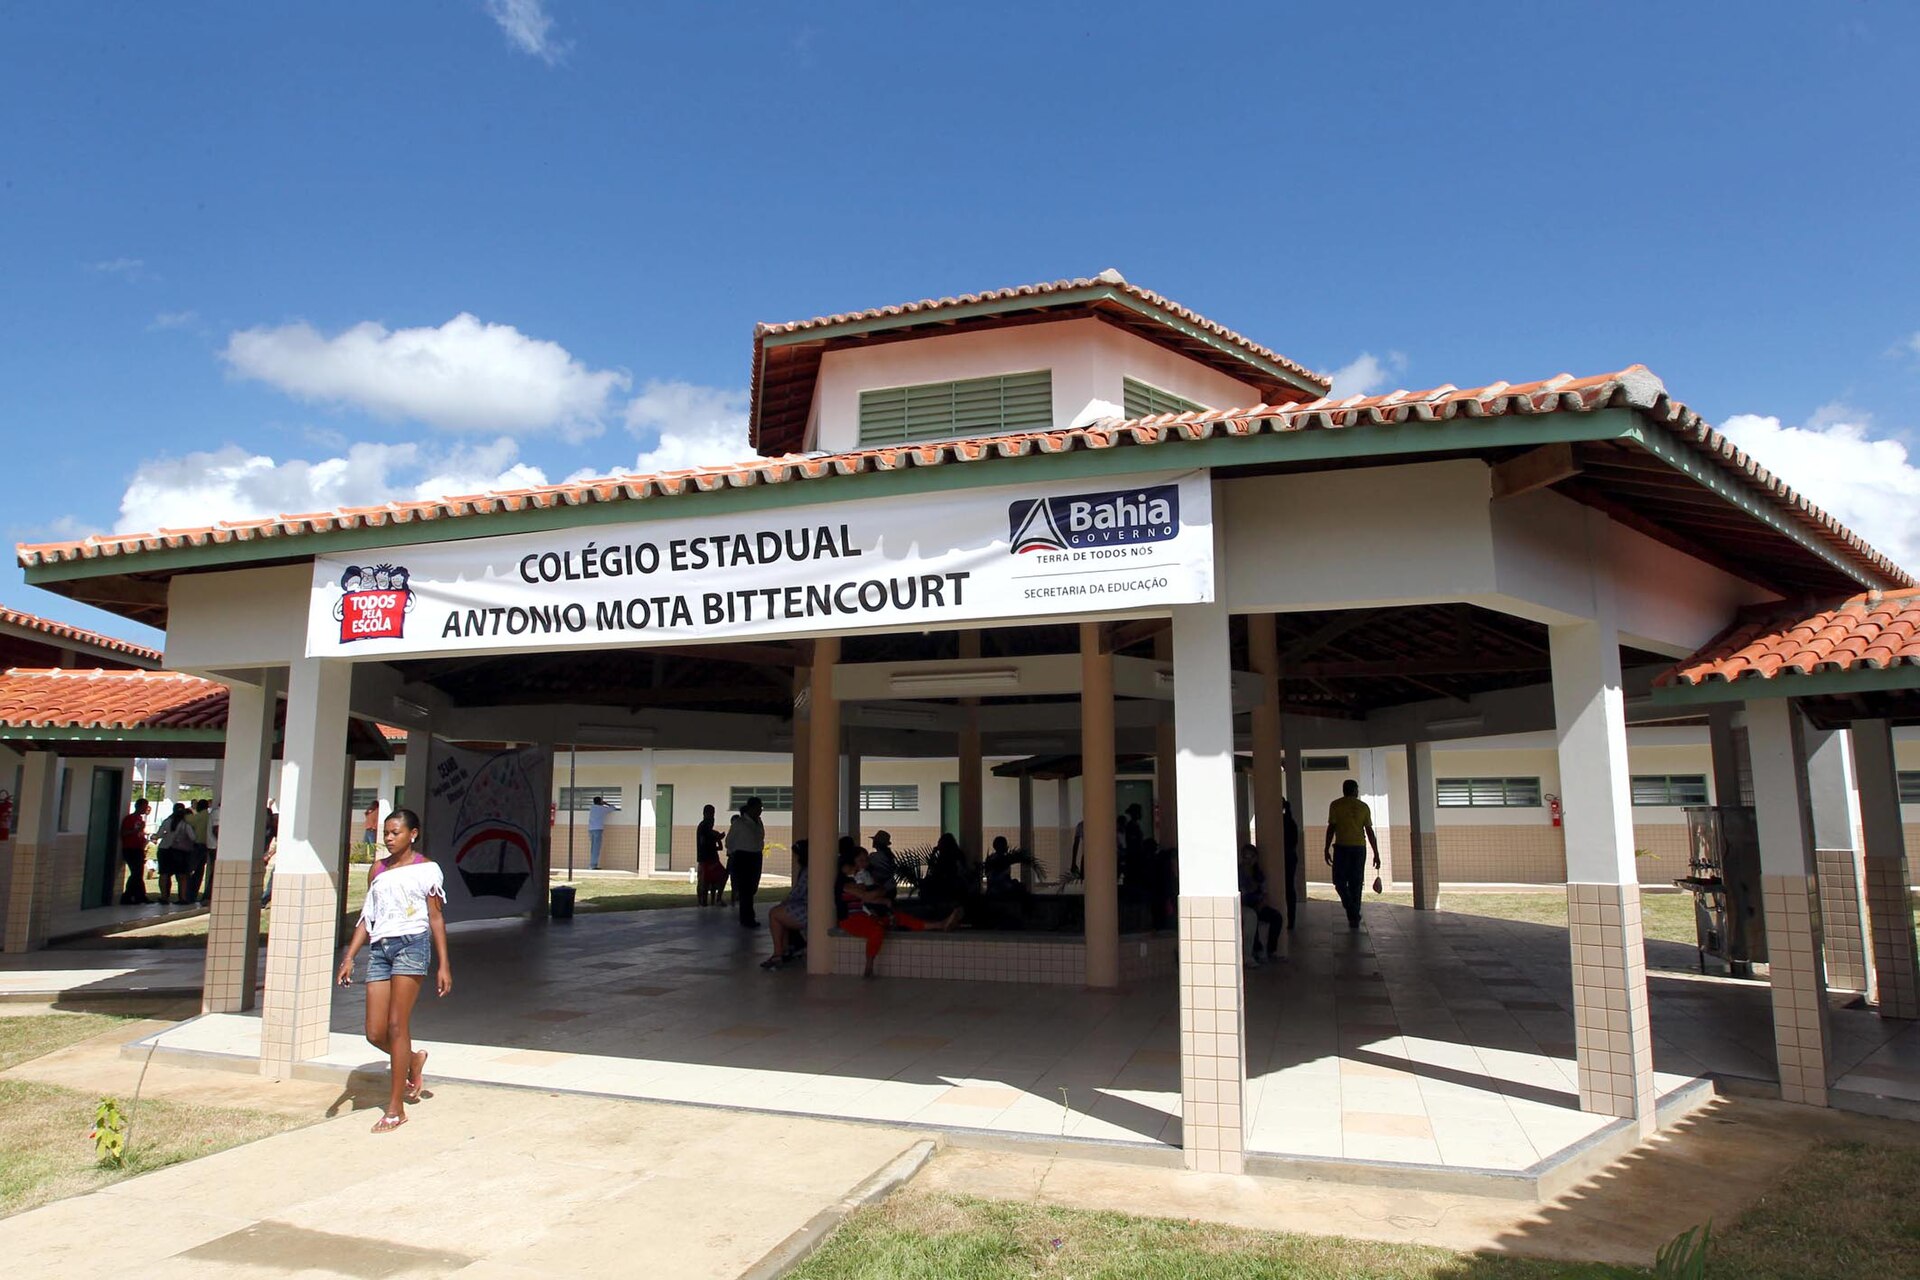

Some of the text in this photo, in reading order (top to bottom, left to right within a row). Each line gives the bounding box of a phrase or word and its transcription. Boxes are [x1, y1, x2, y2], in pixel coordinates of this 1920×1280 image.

[1069, 494, 1171, 531] Bahia
[1071, 526, 1172, 544] GOVERNO
[520, 524, 862, 584] COLÉGIO ESTADUAL
[1036, 546, 1153, 564] TERRA DE TODOS NÓS
[1024, 576, 1168, 599] SECRETARIA DA EDUCAÇÃO
[350, 594, 397, 611] TODOS
[441, 571, 970, 638] ANTONIO MOTA BITTENCOURT
[361, 608, 383, 619] PELA
[352, 616, 392, 633] ESCOLA
